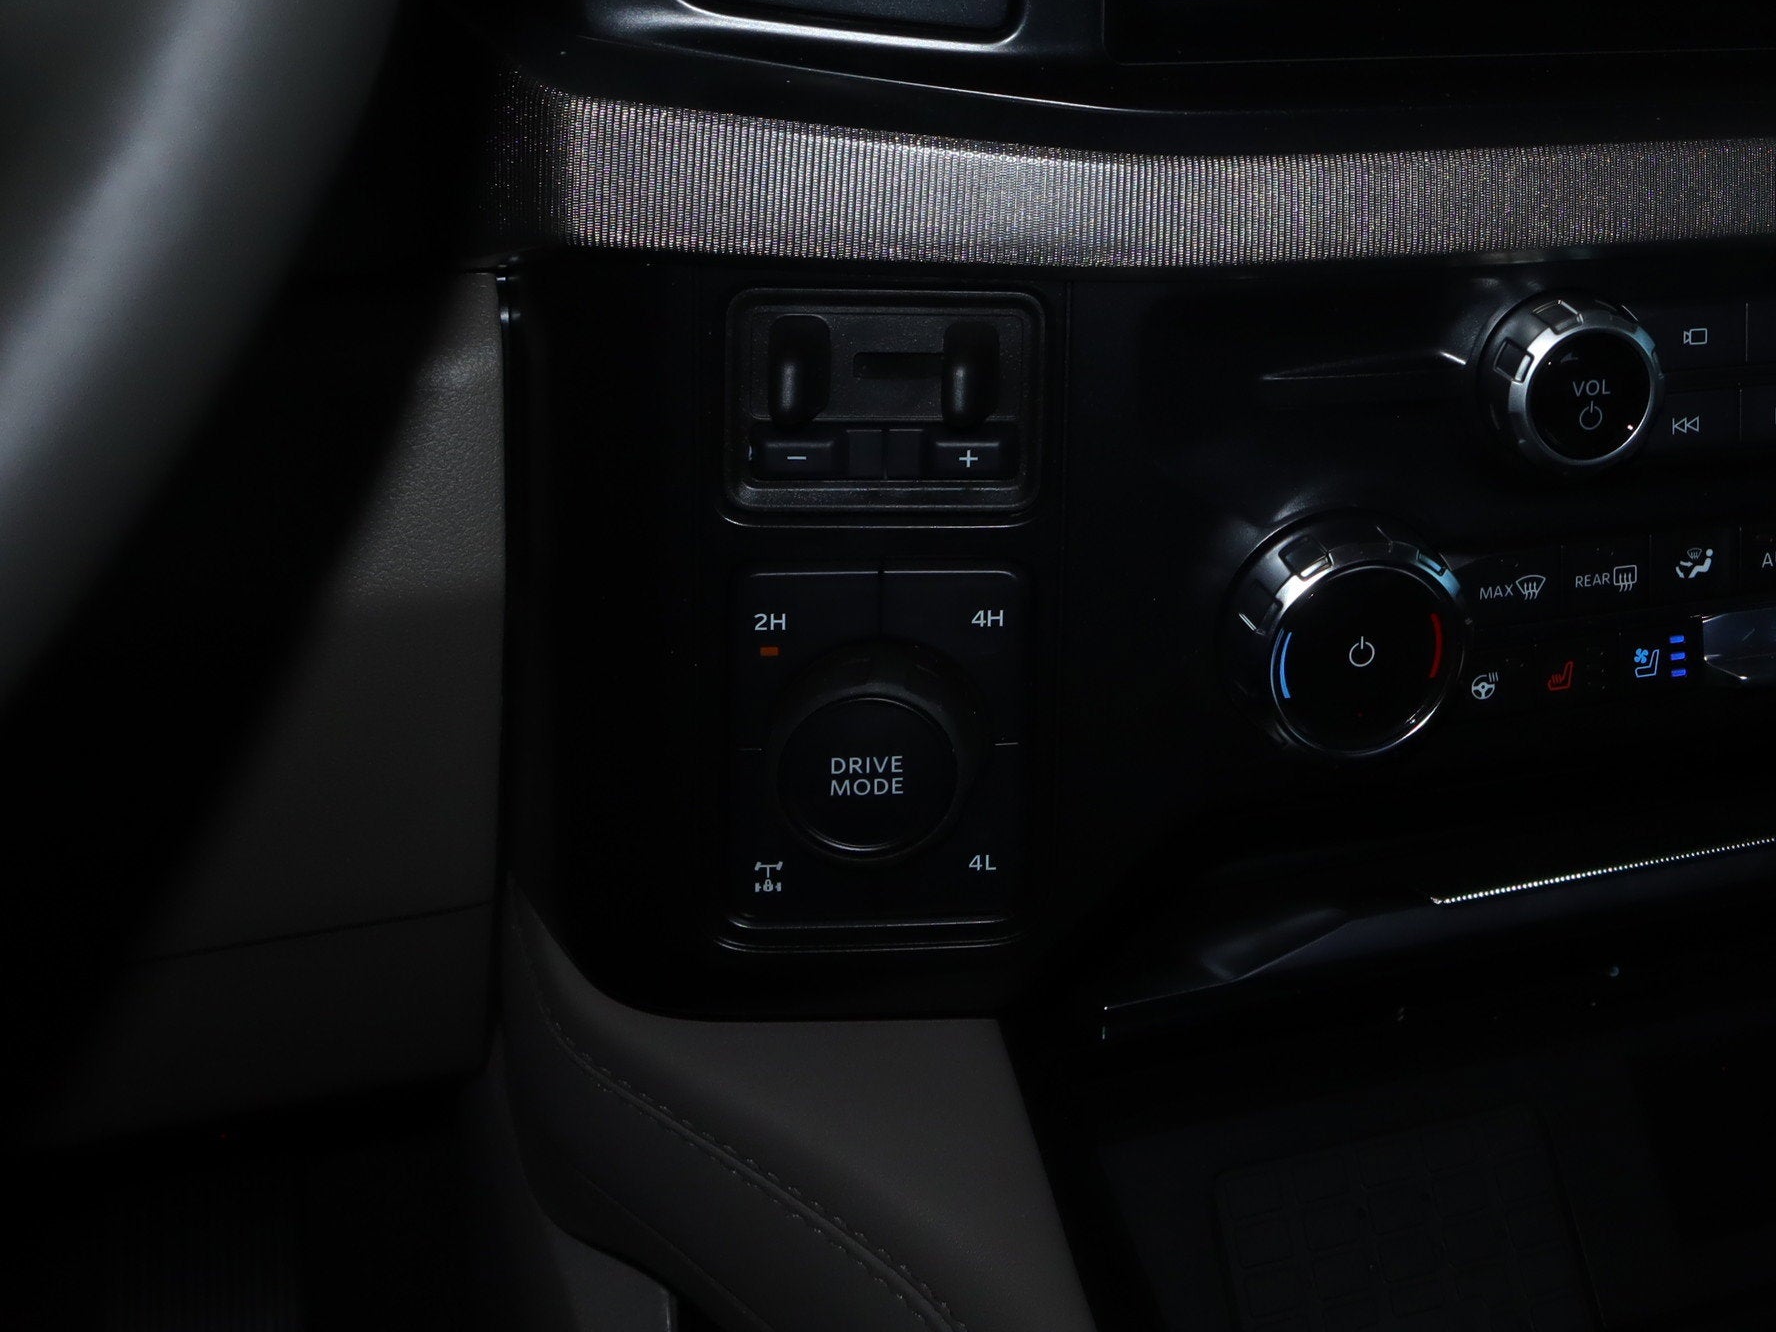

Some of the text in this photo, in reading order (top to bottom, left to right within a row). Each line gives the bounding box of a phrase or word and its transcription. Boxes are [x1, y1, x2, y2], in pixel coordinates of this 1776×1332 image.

[1572, 379, 1611, 397] VOL
[1574, 571, 1611, 588] REAR
[1479, 584, 1514, 600] MAX
[754, 613, 787, 631] 2H
[971, 609, 1005, 628] 4H
[830, 755, 904, 776] DRIVE
[830, 777, 904, 796] MODE
[968, 854, 997, 871] 4L
